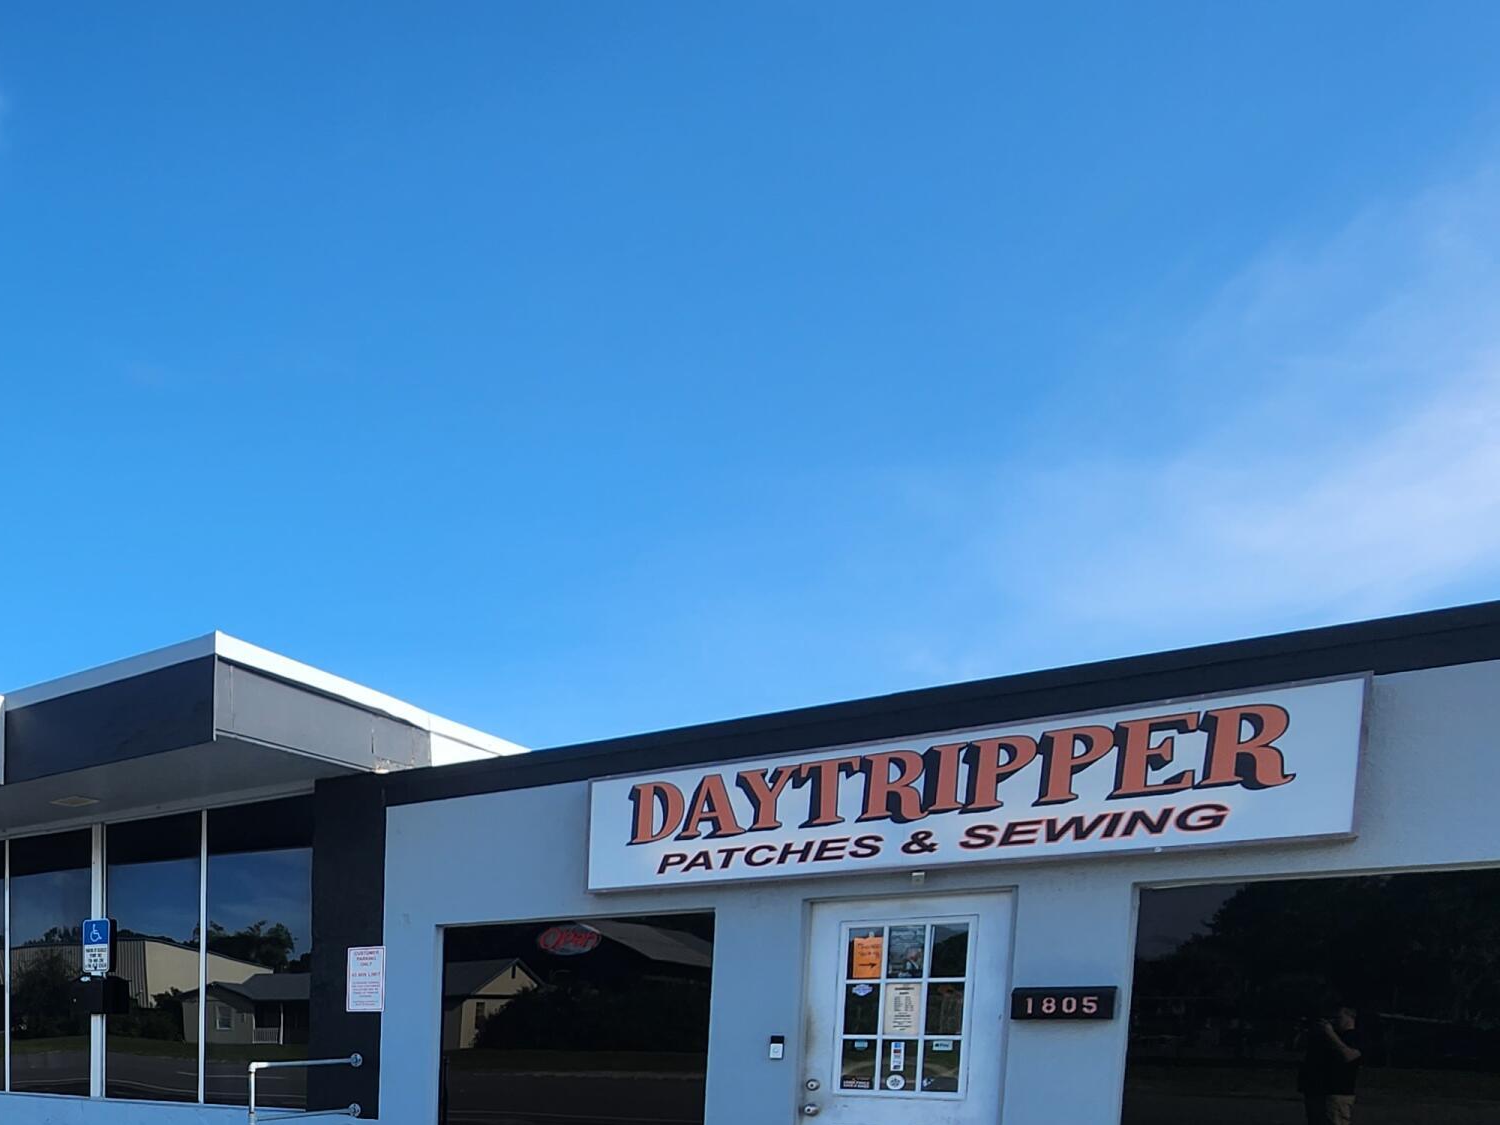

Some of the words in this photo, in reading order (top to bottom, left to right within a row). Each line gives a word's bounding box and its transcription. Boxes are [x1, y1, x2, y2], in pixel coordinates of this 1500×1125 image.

[627, 703, 1296, 846] DAYTRIPPER
[656, 833, 886, 875] PATCHES
[901, 830, 938, 854] &
[958, 803, 1233, 851] SEWING
[1026, 996, 1099, 1014] 1805
